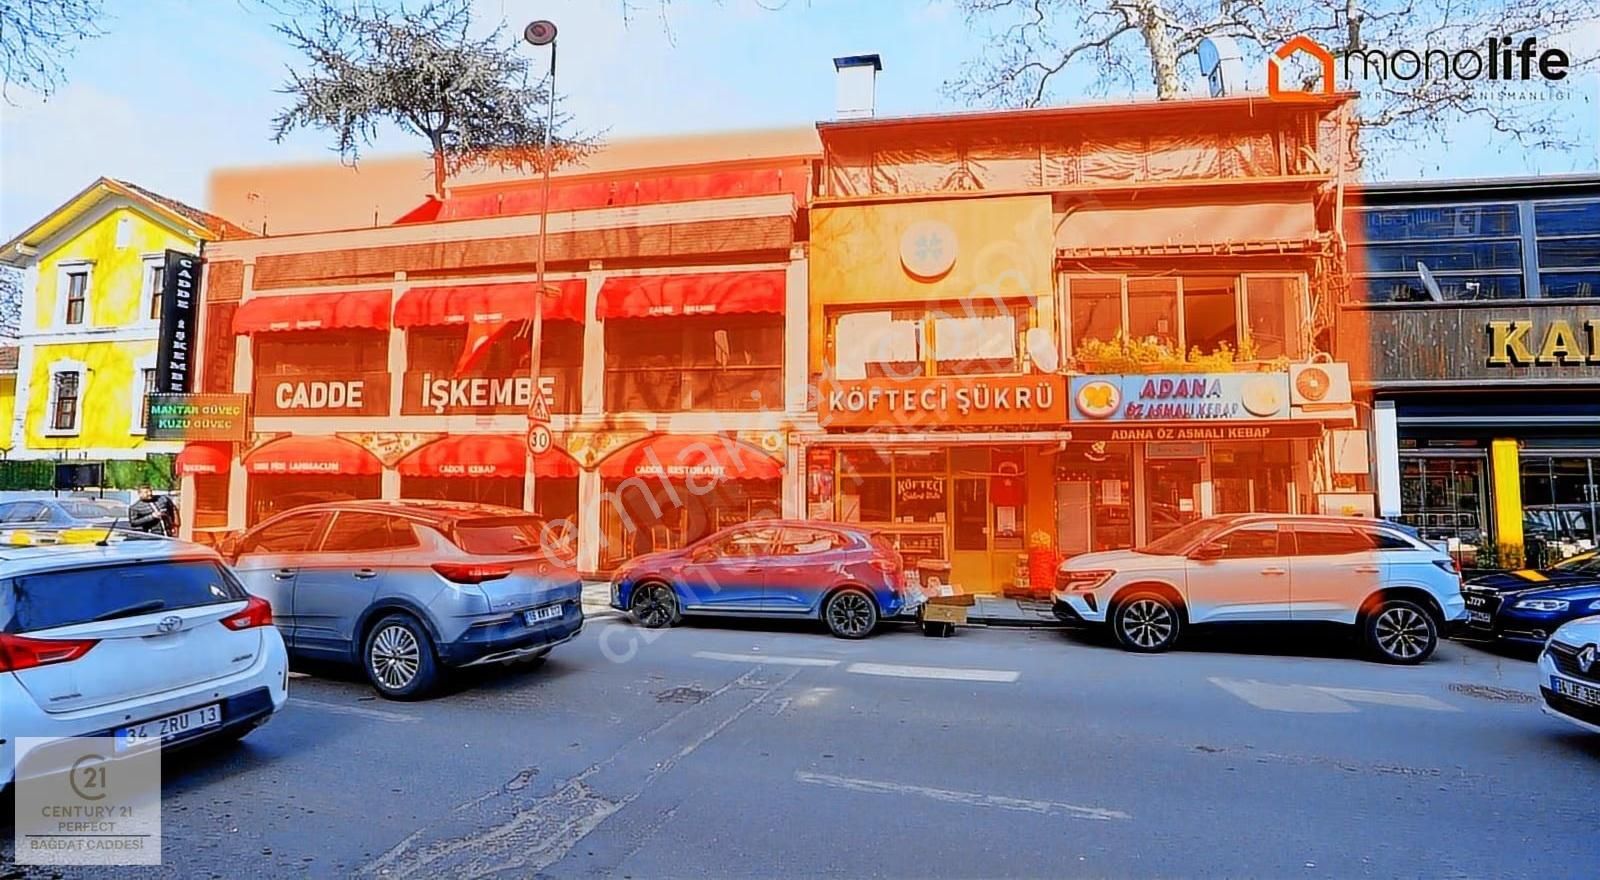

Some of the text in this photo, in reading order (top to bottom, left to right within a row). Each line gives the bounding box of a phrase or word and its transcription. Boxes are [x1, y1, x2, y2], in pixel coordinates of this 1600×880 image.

[1488, 320, 1600, 369] KA
[276, 381, 364, 408] CADDE
[422, 373, 555, 414] İŞKEMBE
[829, 382, 1054, 416] KÖFTECİ ŞÜKRÜ
[1140, 378, 1222, 399] ADANA
[151, 405, 199, 415] MANTAR
[158, 419, 191, 429] KUZU
[1111, 427, 1270, 439] ADANA ÖZ ASMALI KEBAP
[531, 432, 547, 448] 30
[127, 707, 217, 744] 34 ZRU 13
